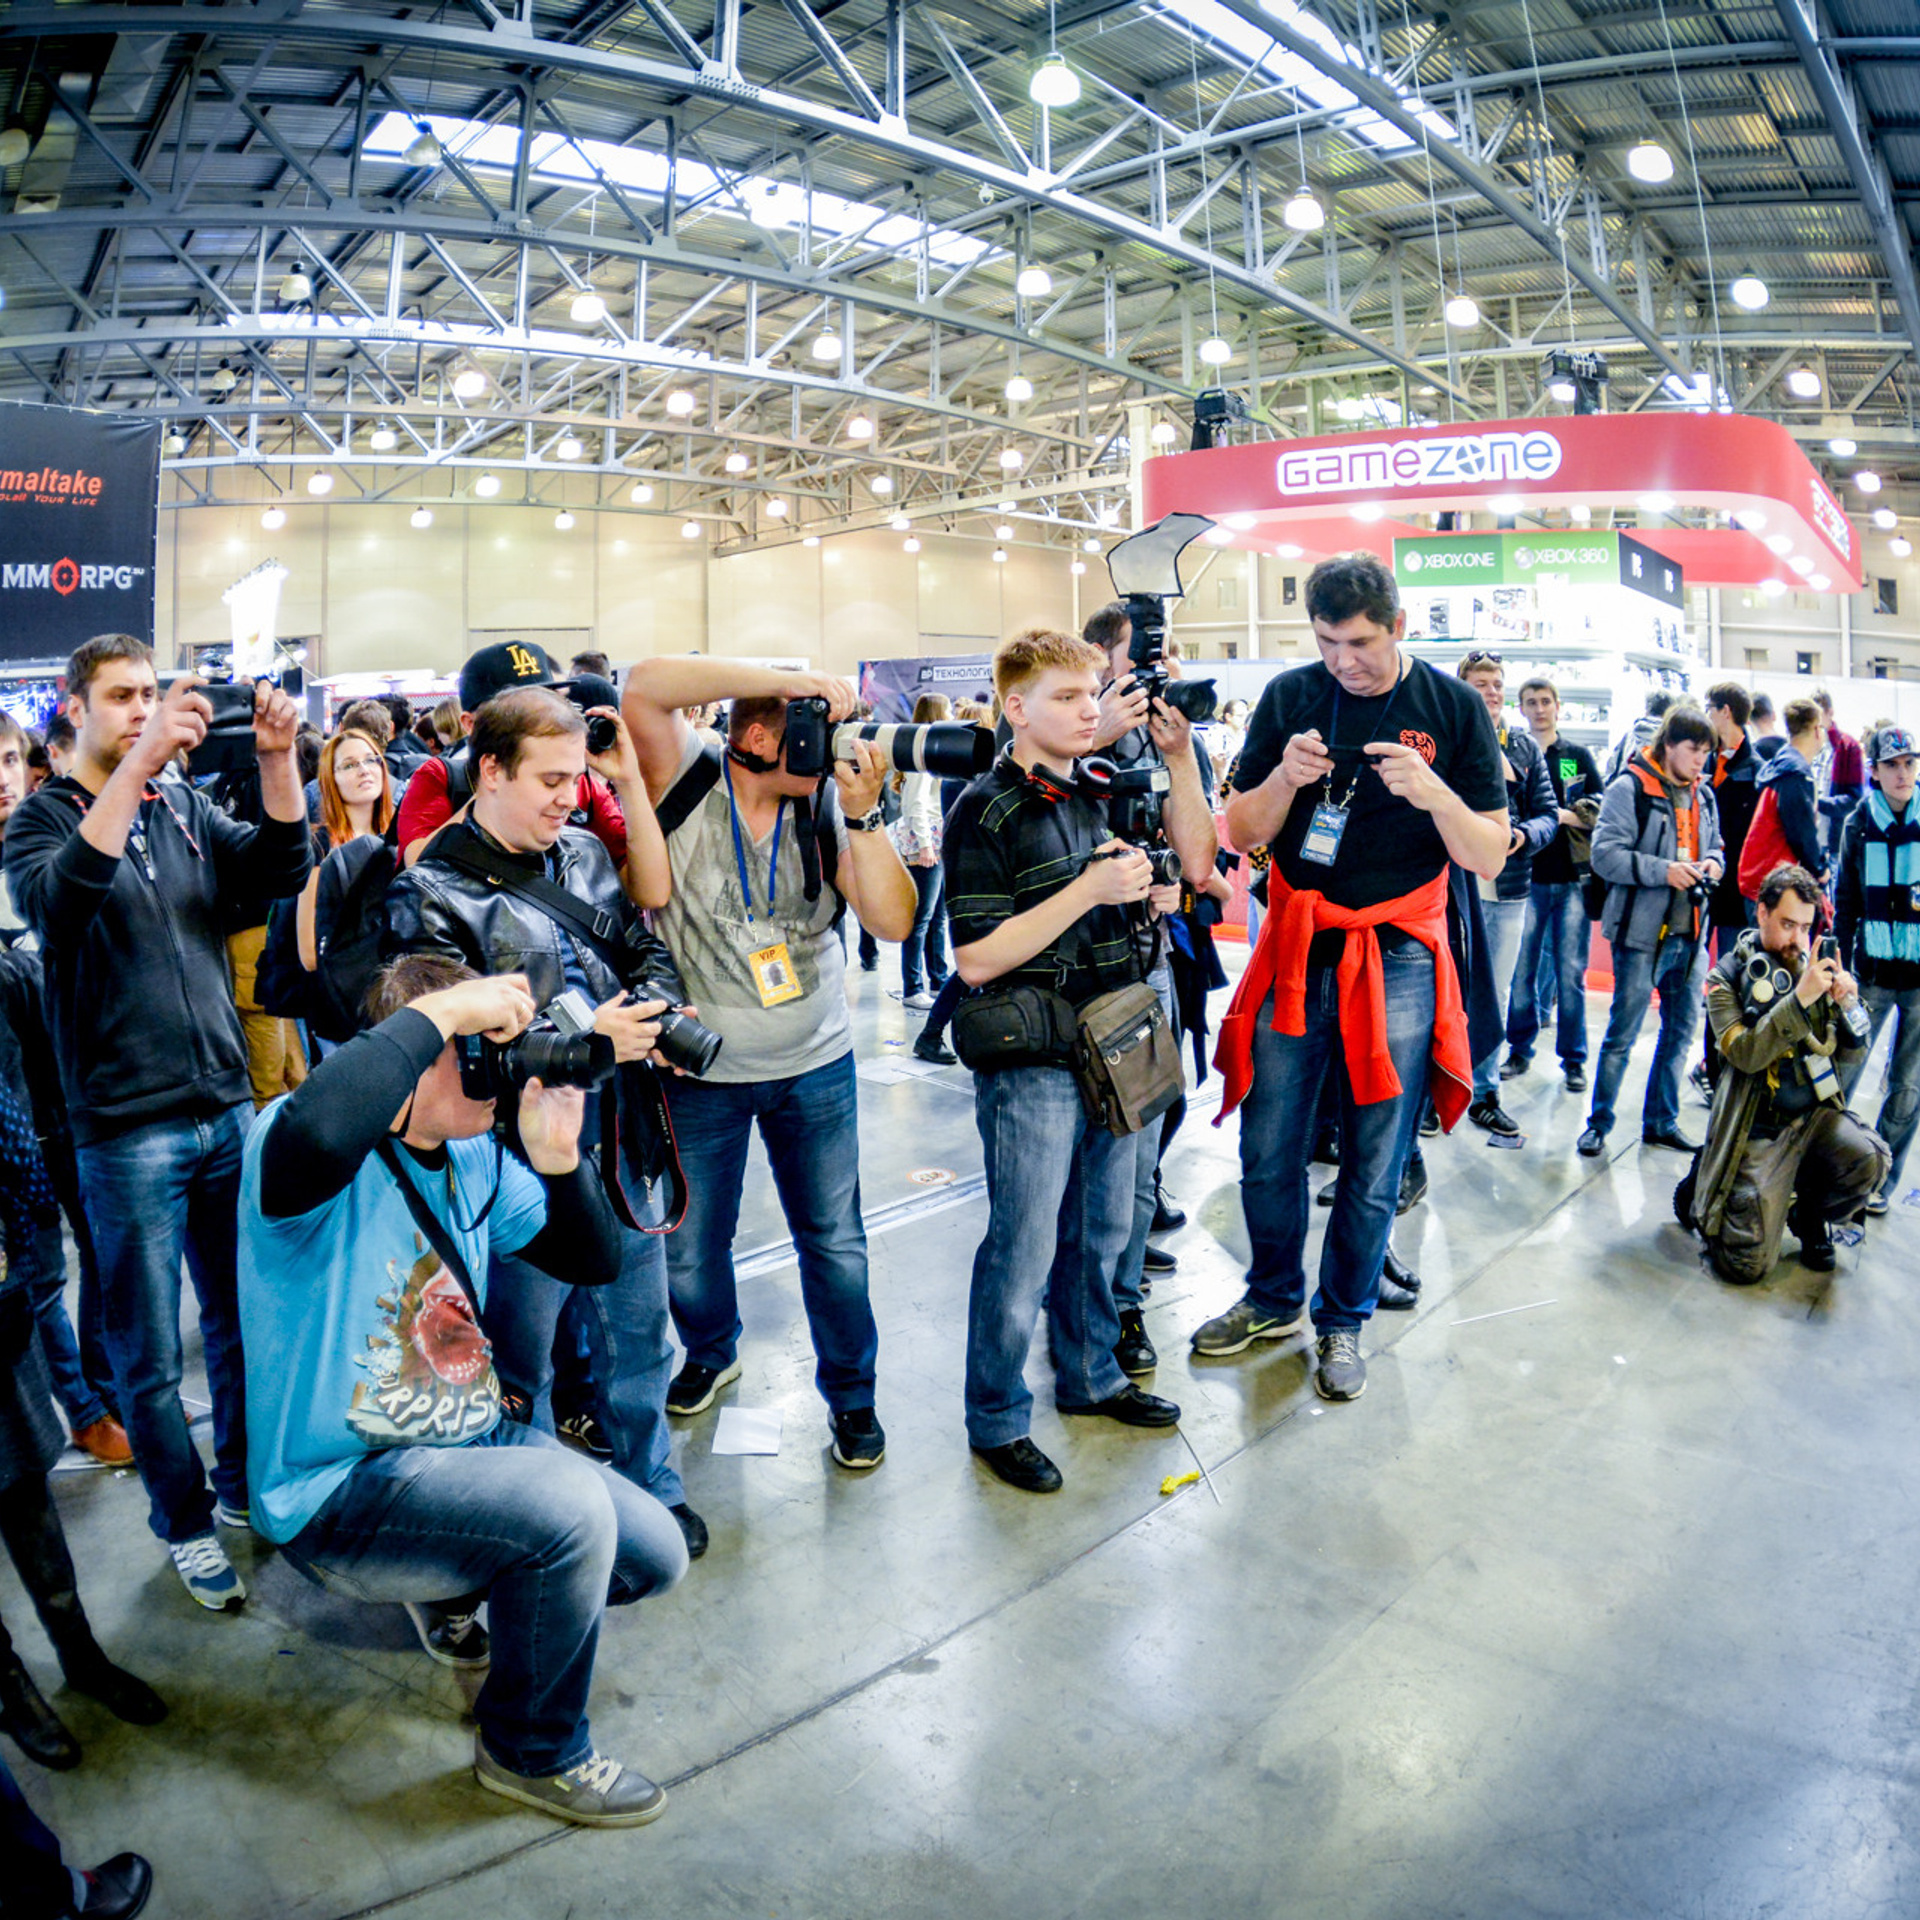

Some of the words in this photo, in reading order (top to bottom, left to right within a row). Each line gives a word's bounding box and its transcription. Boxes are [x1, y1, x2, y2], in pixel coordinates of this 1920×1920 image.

[0, 467, 102, 495] maltake
[1424, 553, 1463, 569] XBOX
[1463, 552, 1495, 567] ONE
[1535, 549, 1577, 564] XBOX
[1578, 547, 1609, 563] 360
[507, 646, 541, 676] LA
